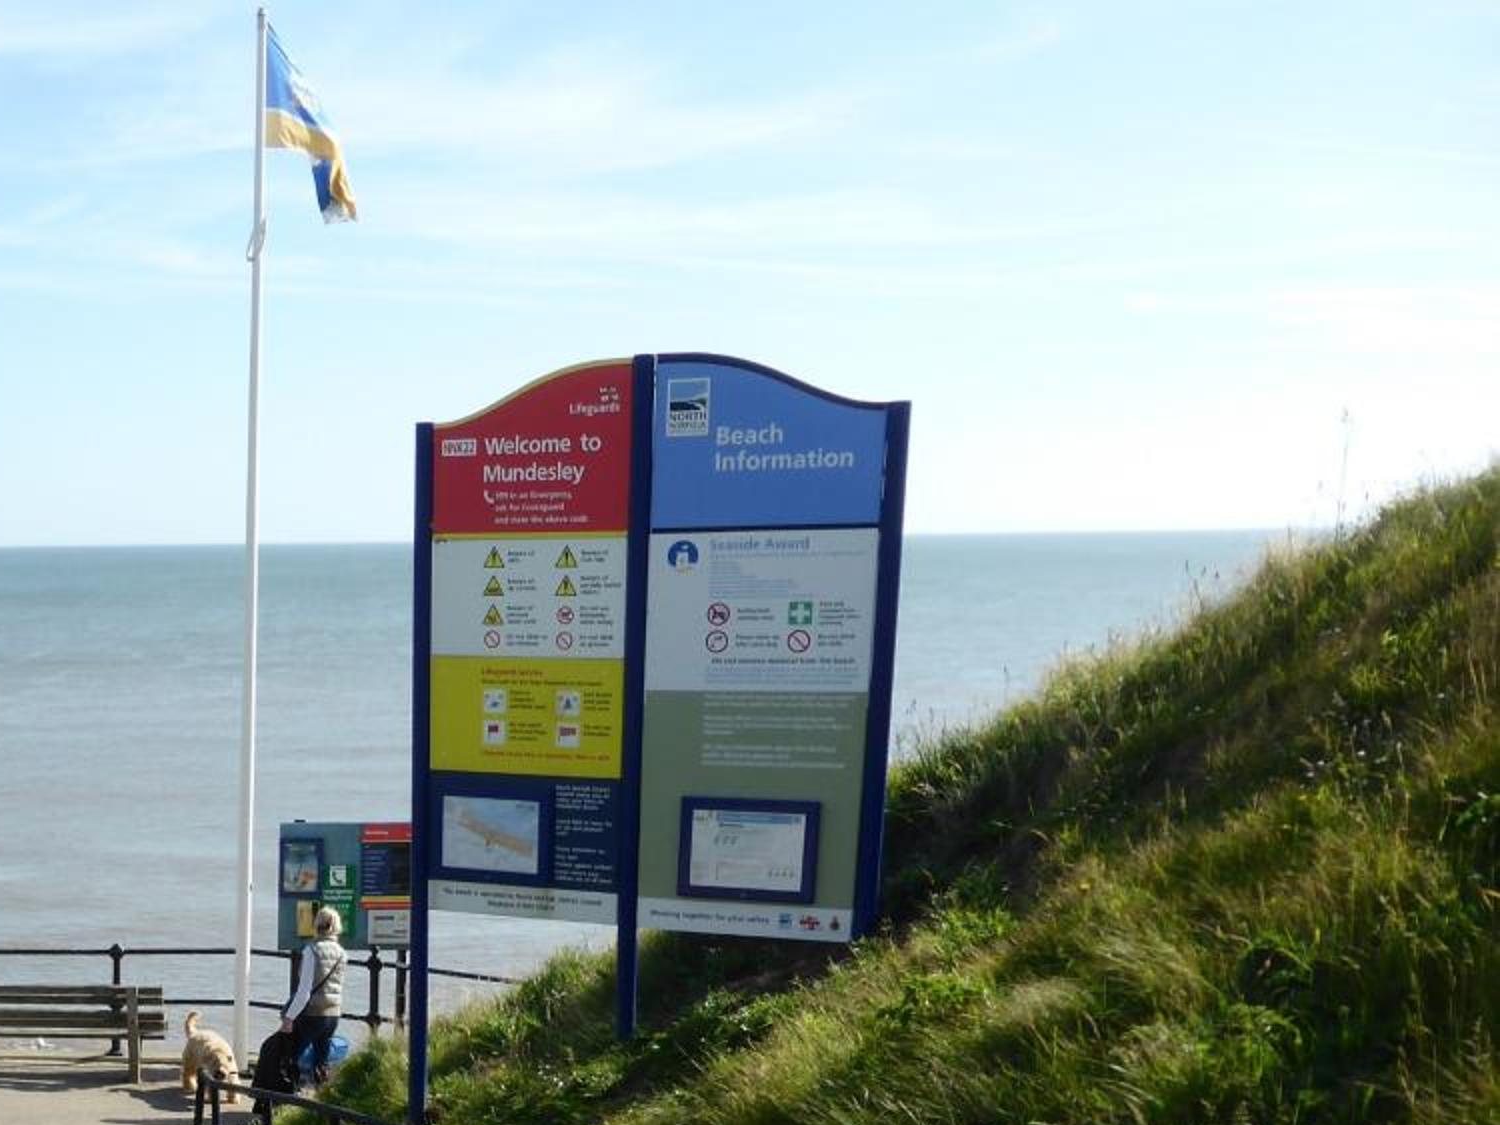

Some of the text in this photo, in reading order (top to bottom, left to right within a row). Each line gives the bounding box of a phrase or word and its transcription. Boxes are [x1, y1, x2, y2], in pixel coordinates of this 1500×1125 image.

[669, 410, 707, 422] NORTH
[484, 434, 602, 455] Welcome to
[716, 423, 784, 446] Beach
[715, 449, 855, 471] Information
[484, 462, 585, 484] Mundesley
